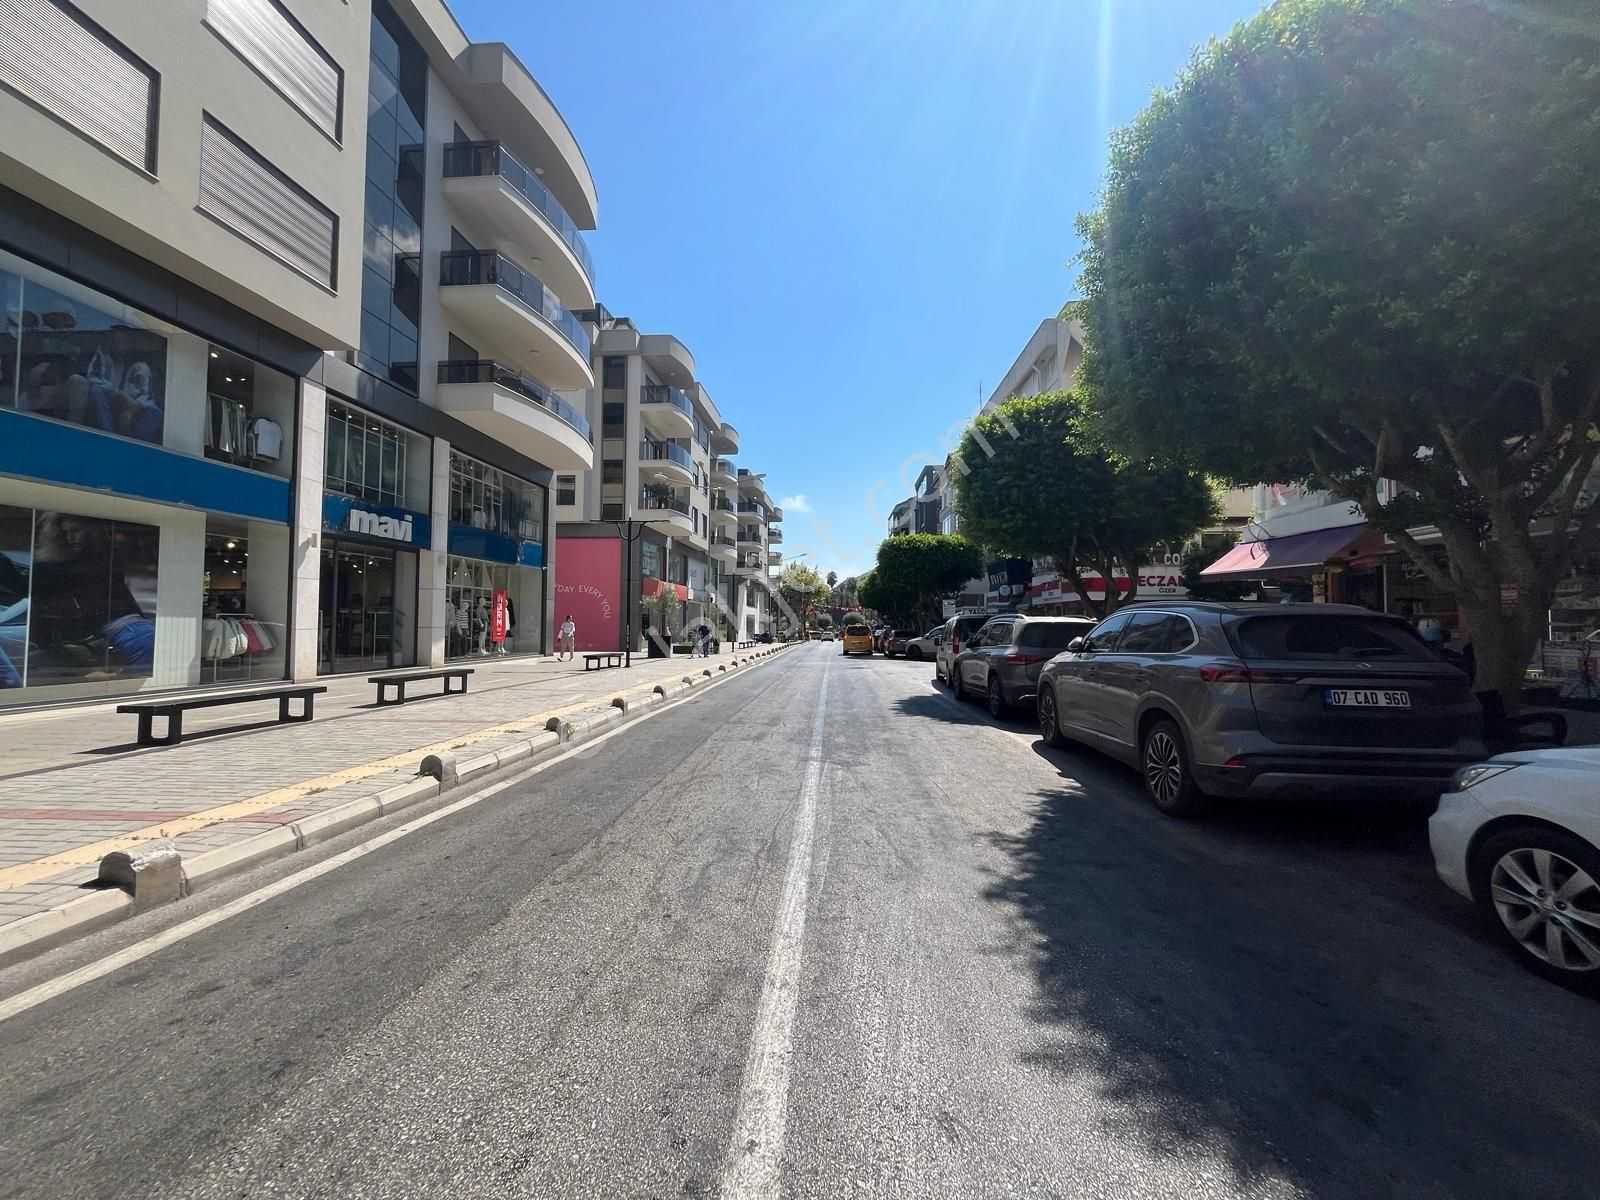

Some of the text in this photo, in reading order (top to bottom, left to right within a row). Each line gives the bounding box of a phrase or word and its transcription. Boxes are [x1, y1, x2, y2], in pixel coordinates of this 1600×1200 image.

[350, 509, 413, 542] mavi
[578, 584, 604, 599] EVERY
[600, 598, 612, 618] YOU
[1332, 691, 1408, 706] 07 CAD 960
